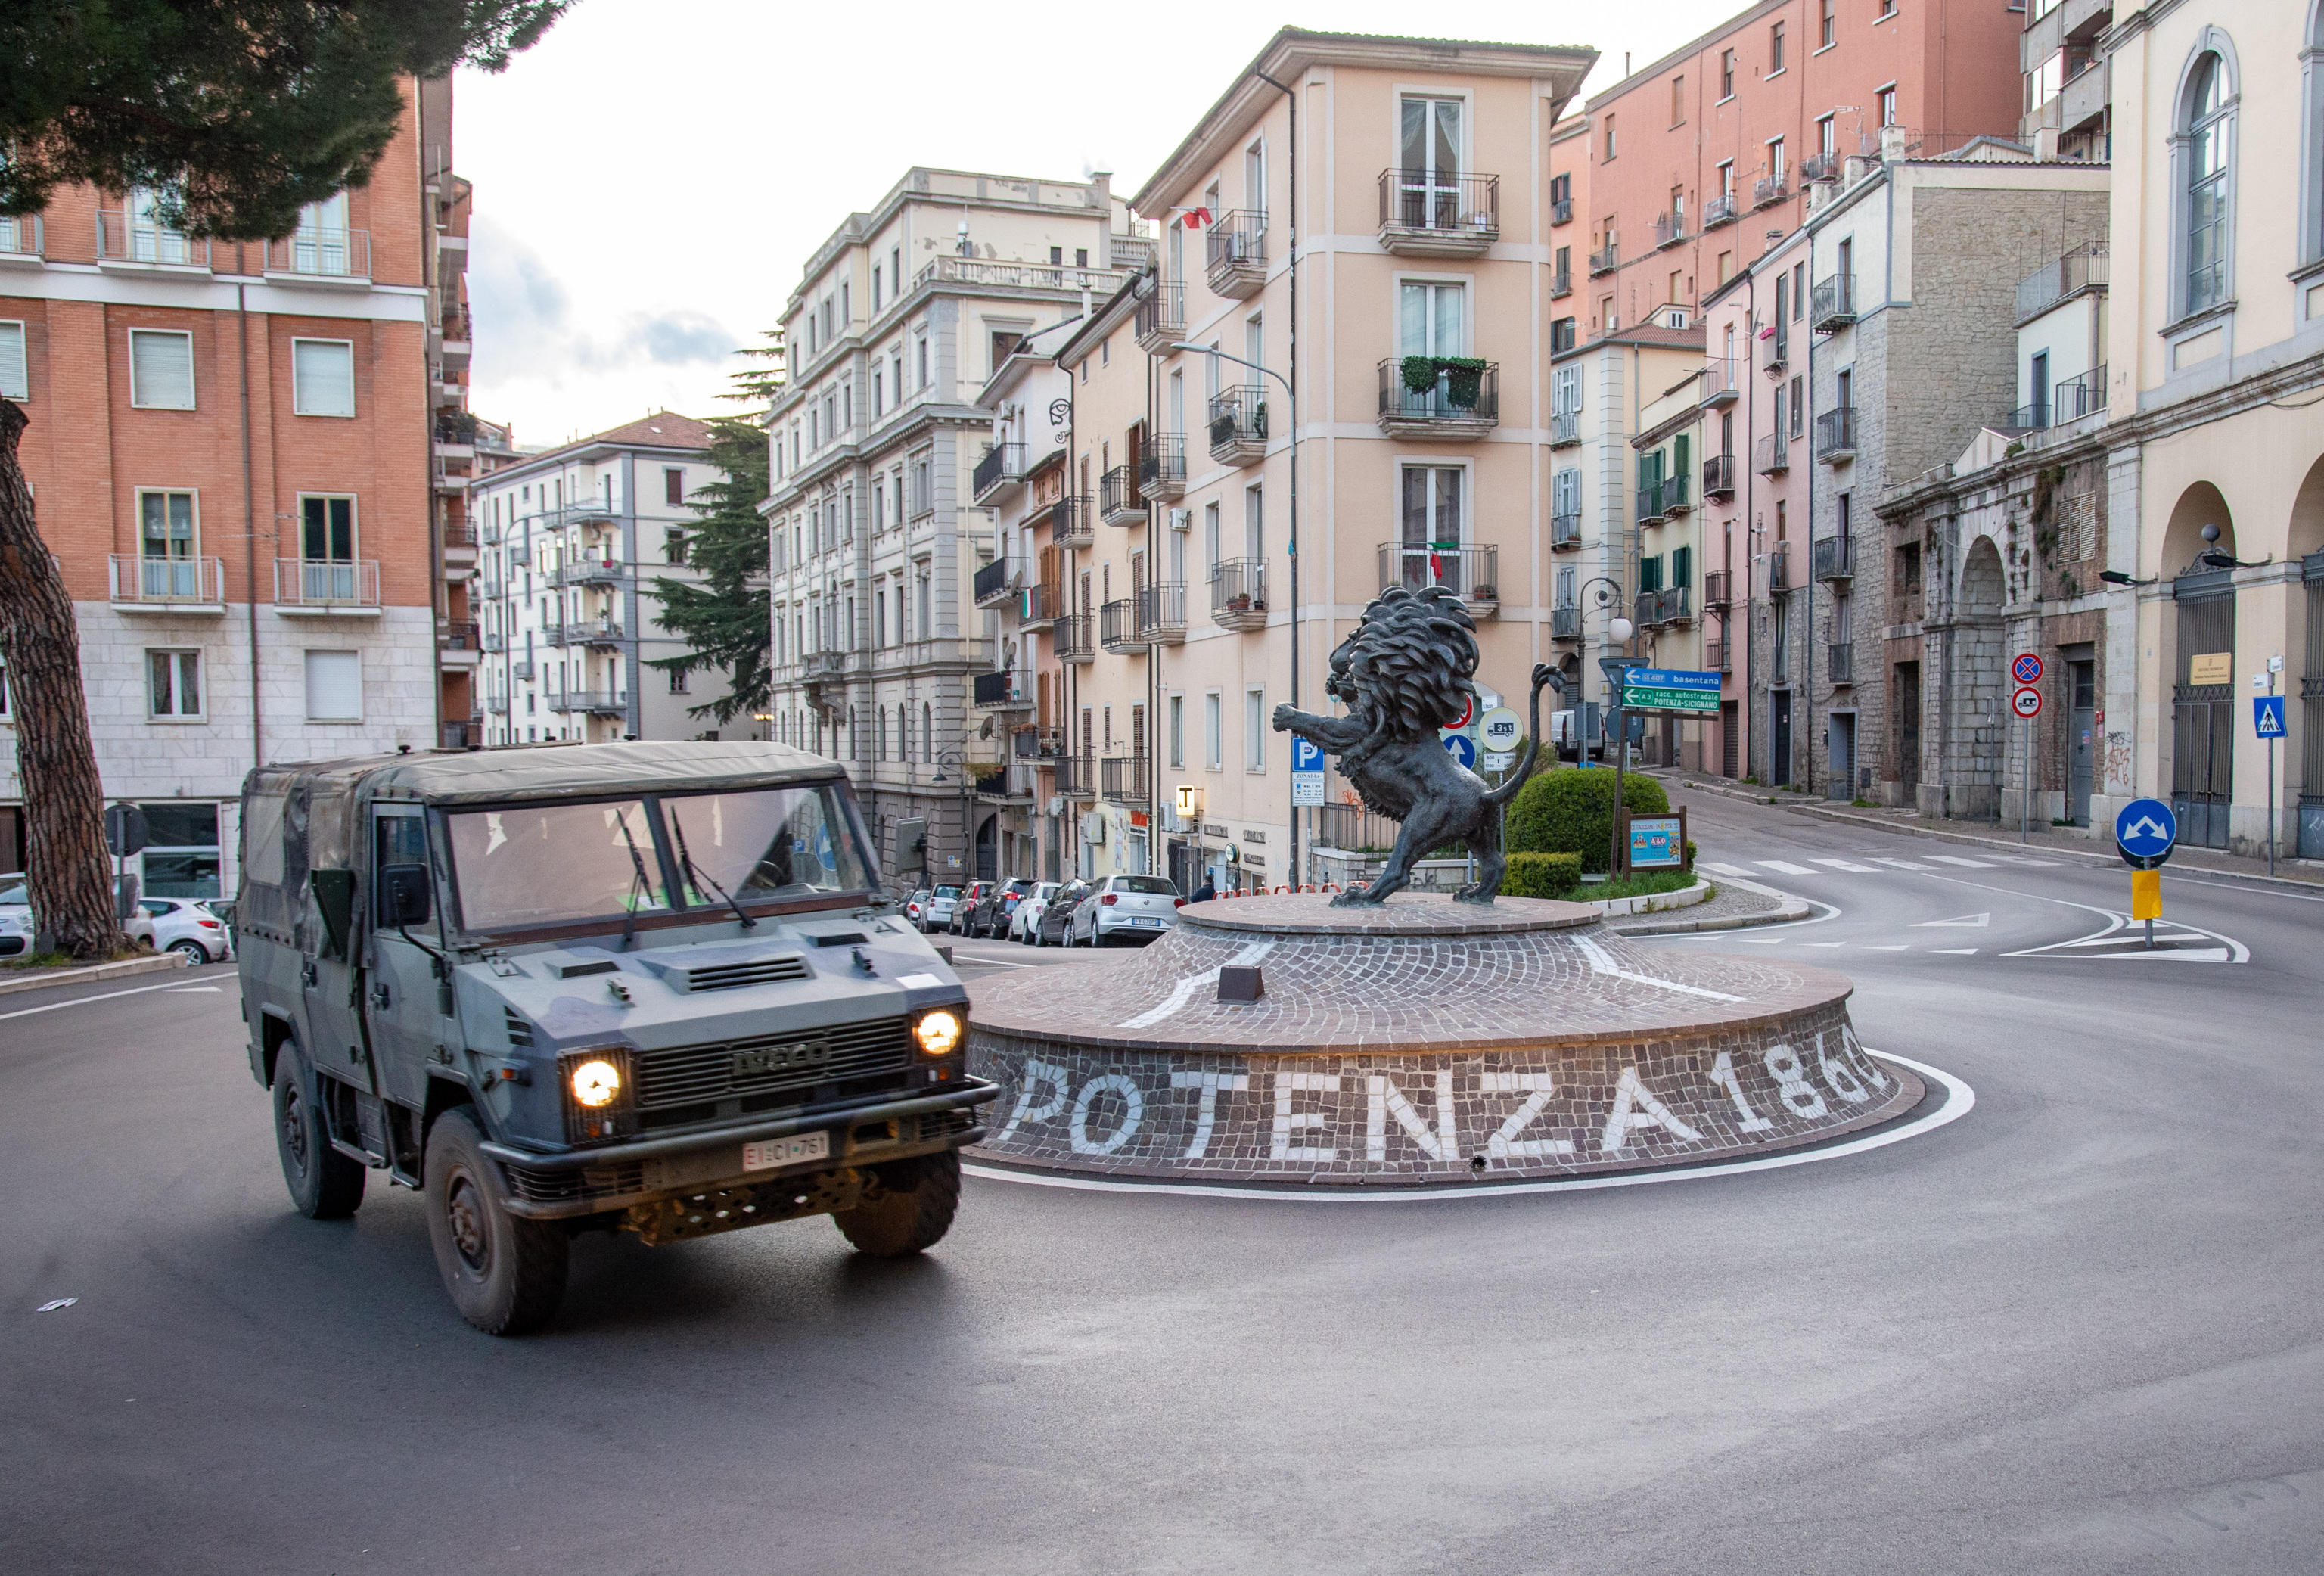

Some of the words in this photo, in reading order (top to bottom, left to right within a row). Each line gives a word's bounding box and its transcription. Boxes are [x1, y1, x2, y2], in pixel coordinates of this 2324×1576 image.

[1673, 675, 1719, 685] basentana
[1654, 698, 1717, 709] POTENZA-SICIGNANO
[1675, 692, 1718, 701] autostradale
[1299, 741, 1318, 768] P
[1179, 788, 1192, 807] T
[998, 1059, 1705, 1161] POTENZA
[744, 1147, 763, 1165] EI
